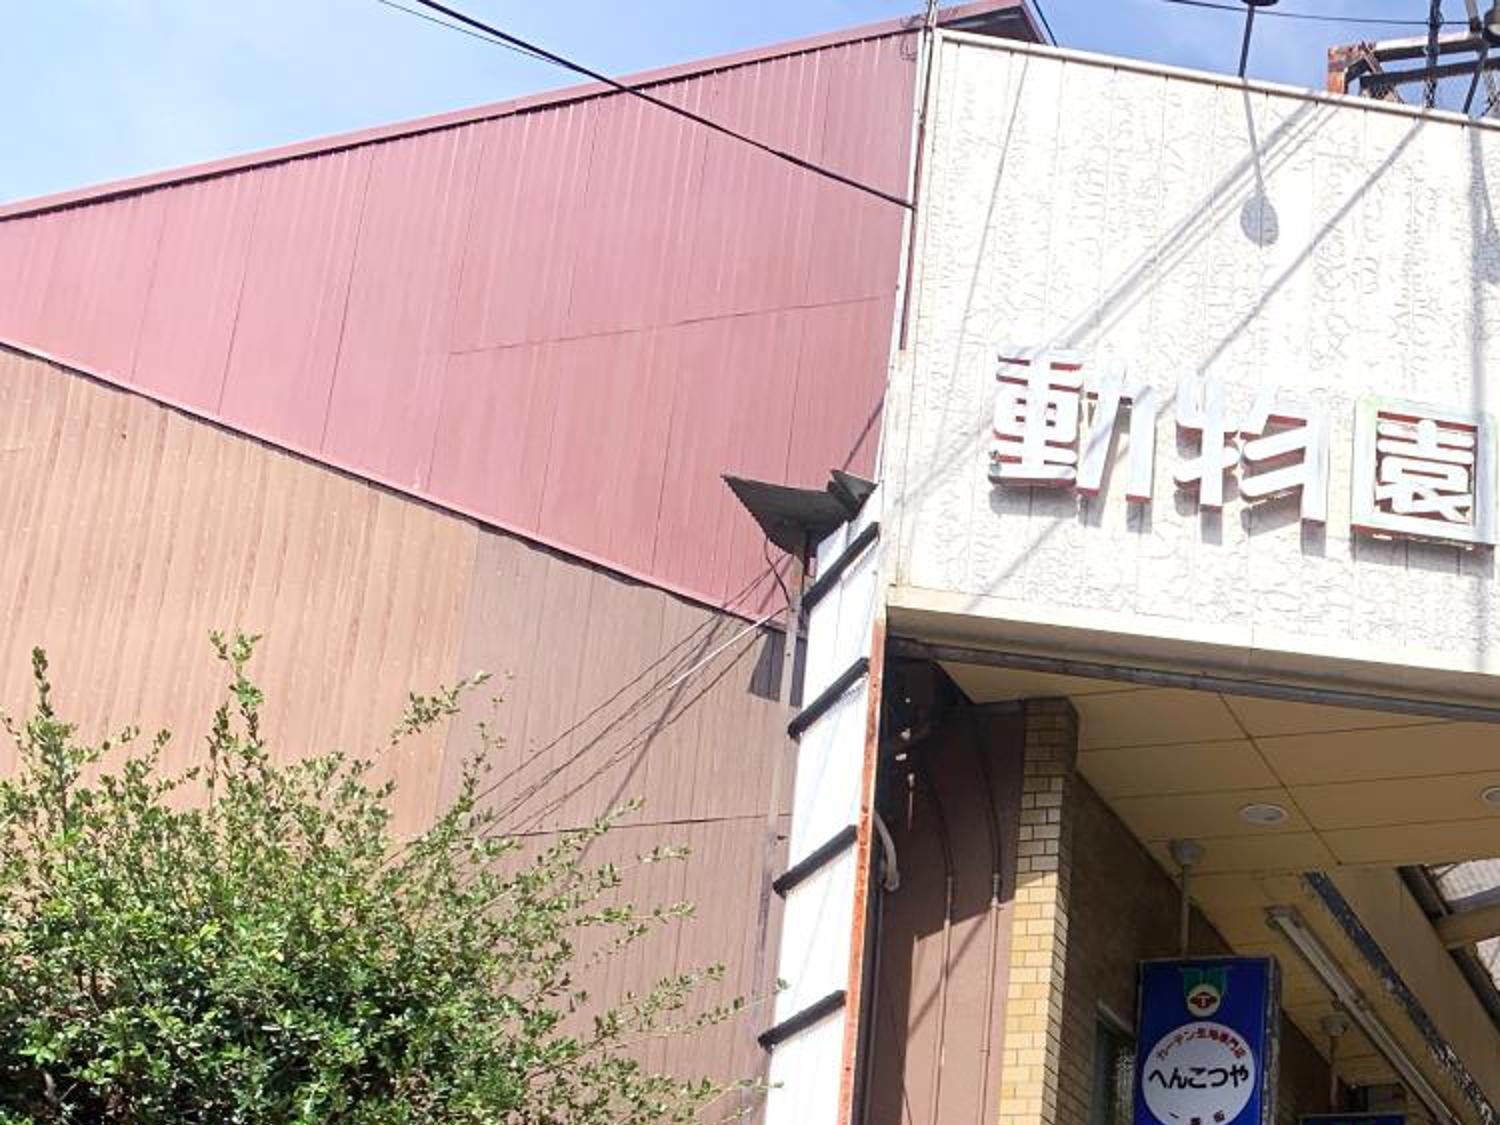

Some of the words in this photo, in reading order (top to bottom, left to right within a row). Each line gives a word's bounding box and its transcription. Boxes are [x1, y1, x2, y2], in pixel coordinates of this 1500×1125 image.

[1148, 1064, 1249, 1088] へんこつや
